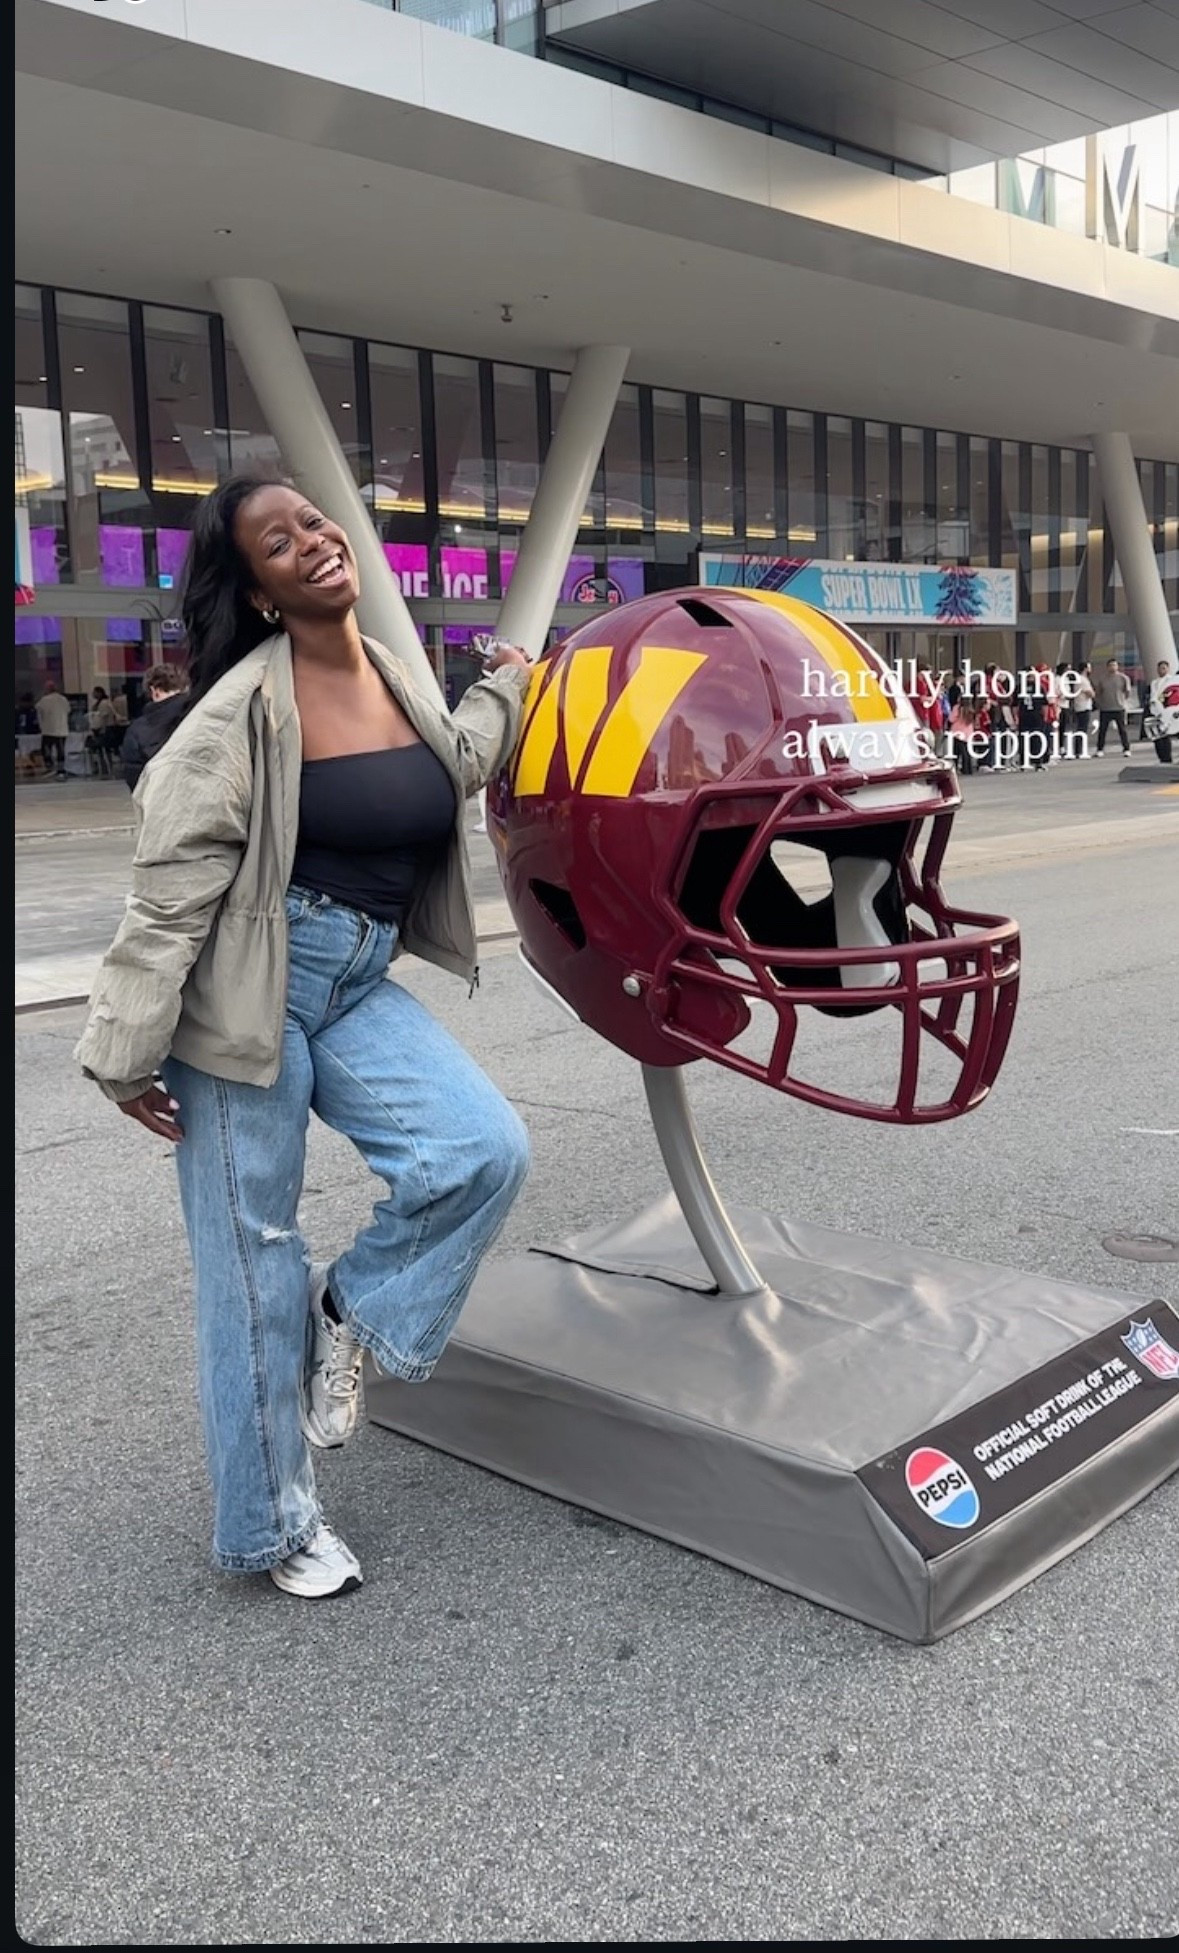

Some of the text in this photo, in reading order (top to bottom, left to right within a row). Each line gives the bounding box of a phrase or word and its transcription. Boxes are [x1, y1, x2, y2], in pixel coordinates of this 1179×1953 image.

[821, 574, 923, 610] SUPER BOWL LX
[1141, 1344, 1178, 1374] NFL
[973, 1357, 1128, 1462] OFFICIAL SOFT DRINK OF THE
[984, 1369, 1143, 1481] NATIONAL FOOTBALL LEAGUE
[917, 1469, 967, 1508] PEPSI
